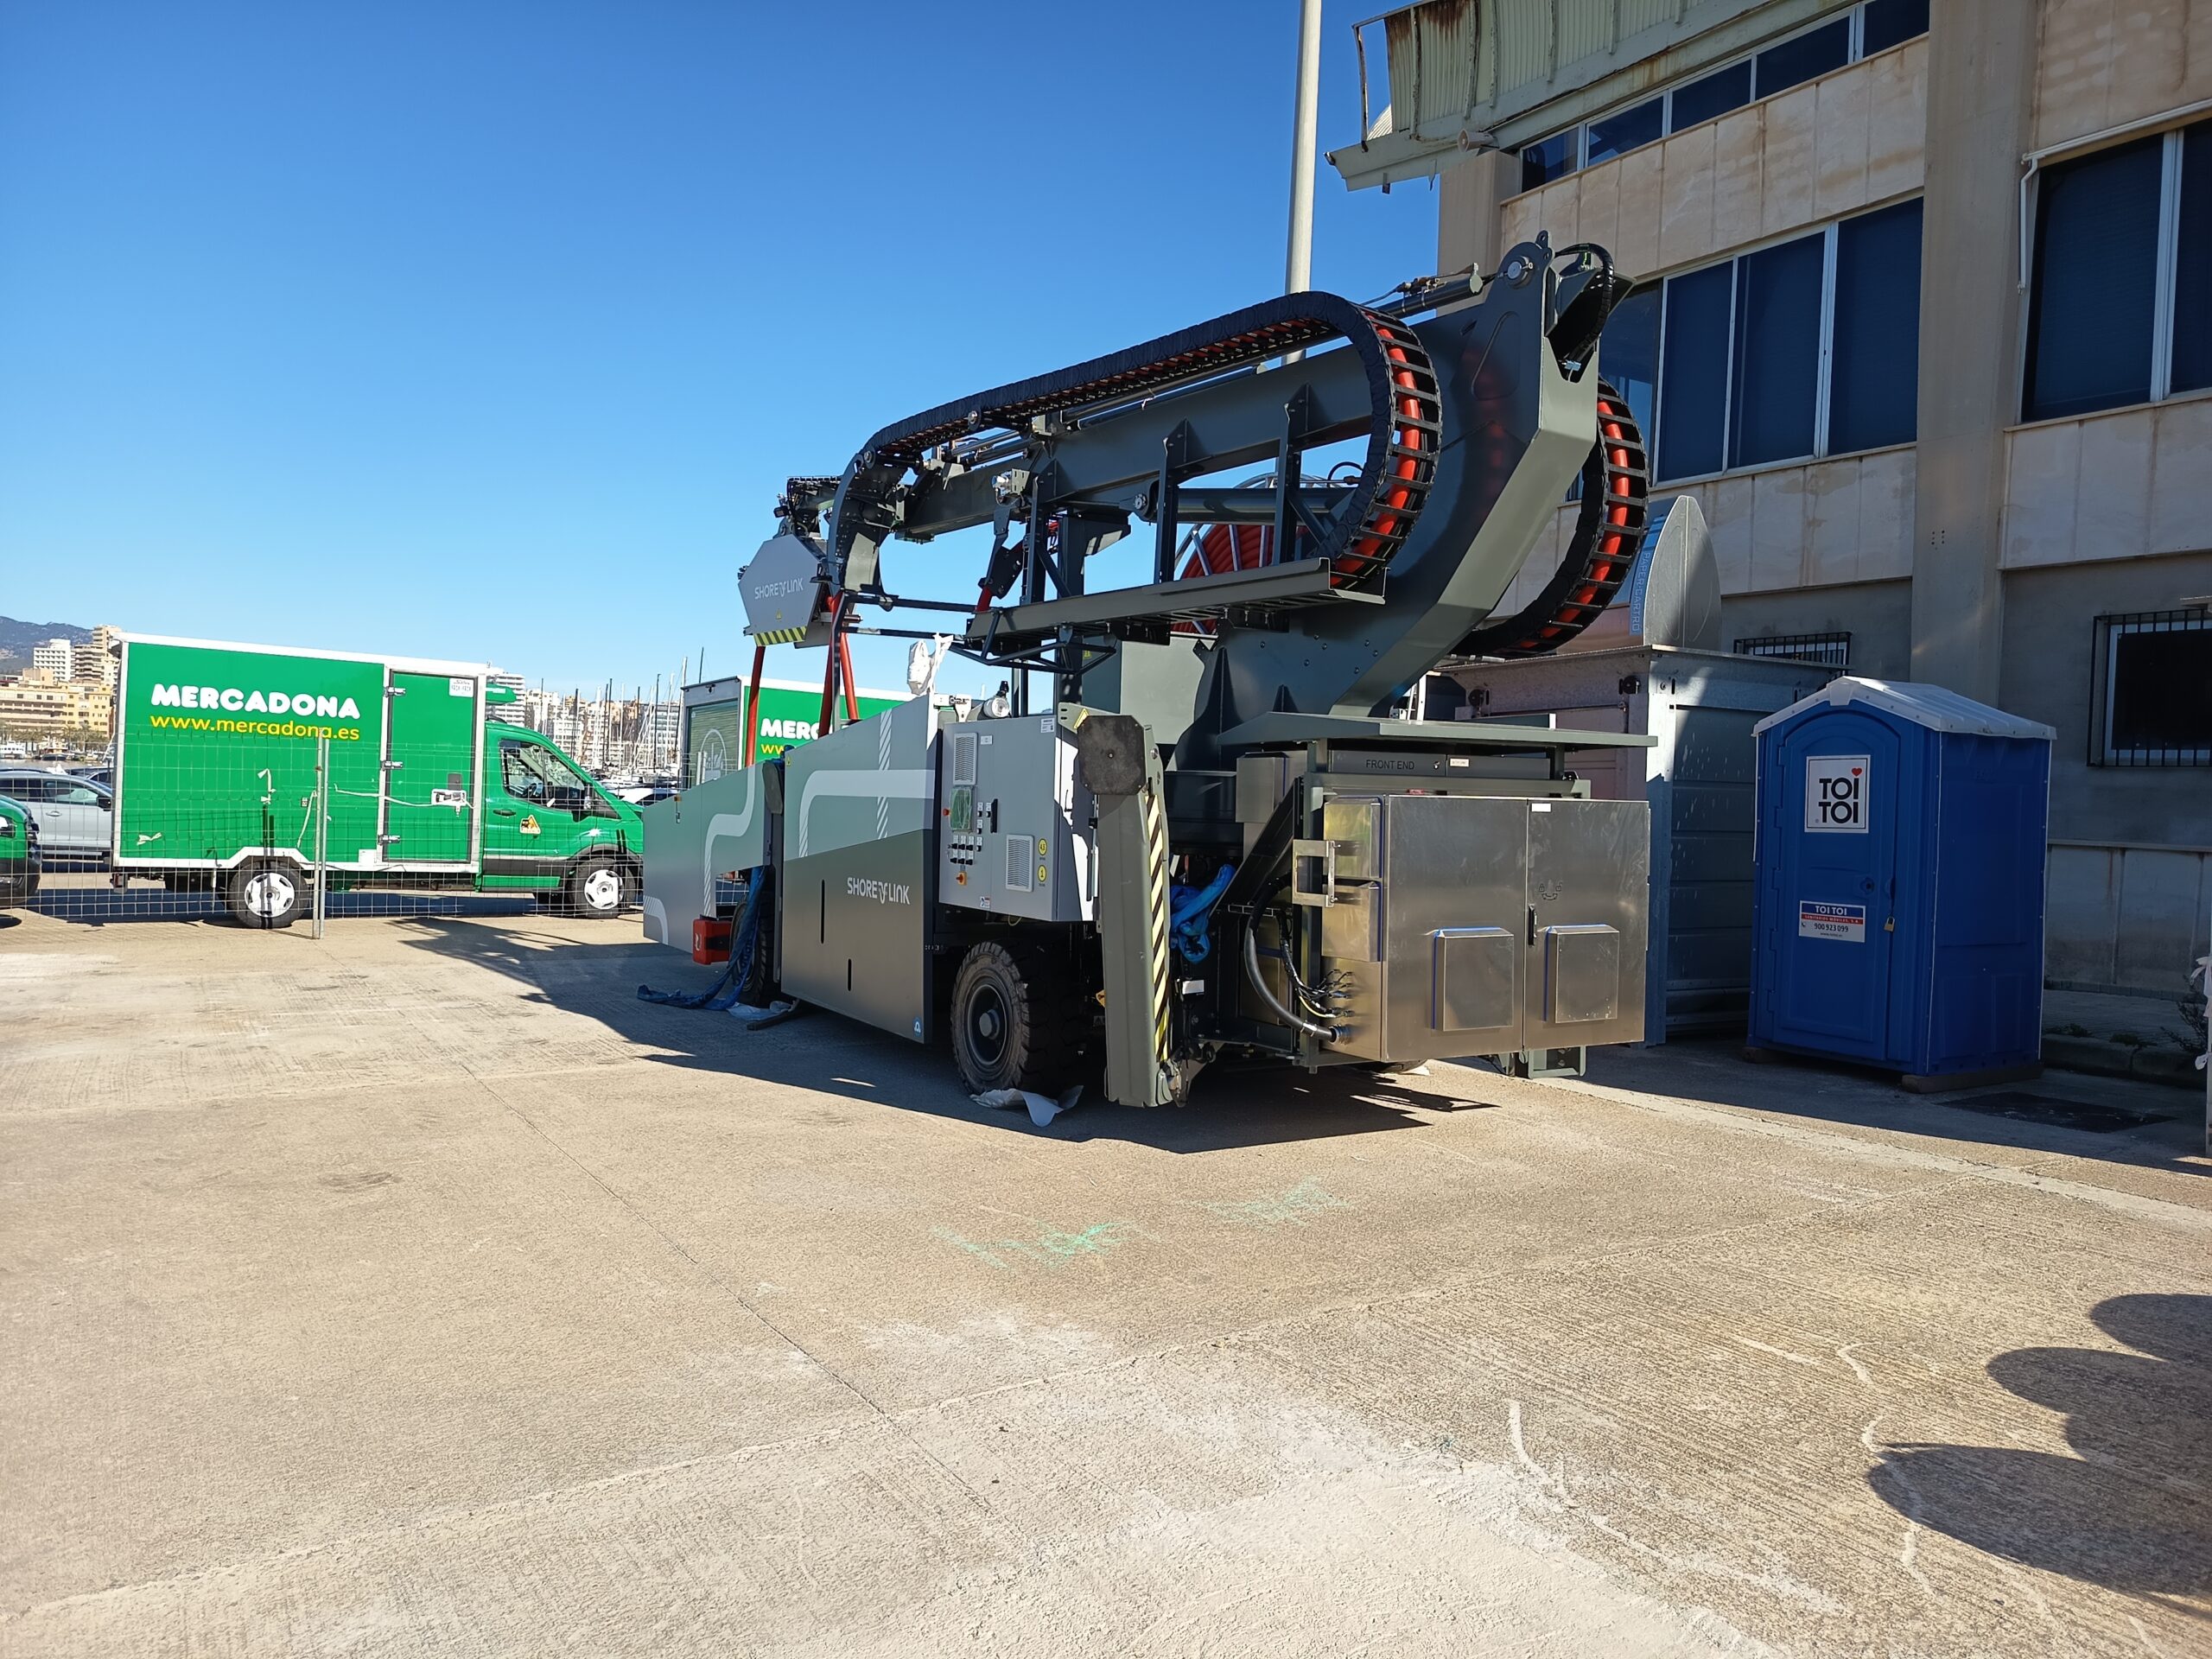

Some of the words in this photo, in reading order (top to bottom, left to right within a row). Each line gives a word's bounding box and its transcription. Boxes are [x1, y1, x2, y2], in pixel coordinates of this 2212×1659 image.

[754, 583, 779, 600] SHORE
[786, 578, 804, 594] LINK
[150, 683, 361, 720] MERCADONA
[149, 715, 360, 741] www.mercadona.es
[1365, 760, 1395, 769] FRONT
[1396, 760, 1414, 770] END
[1819, 778, 1859, 800] TOI
[1818, 801, 1859, 823] TOI
[847, 876, 878, 899] SHORE
[888, 882, 911, 906] LINK
[1815, 905, 1830, 914] TOI
[1831, 906, 1847, 916] TOI
